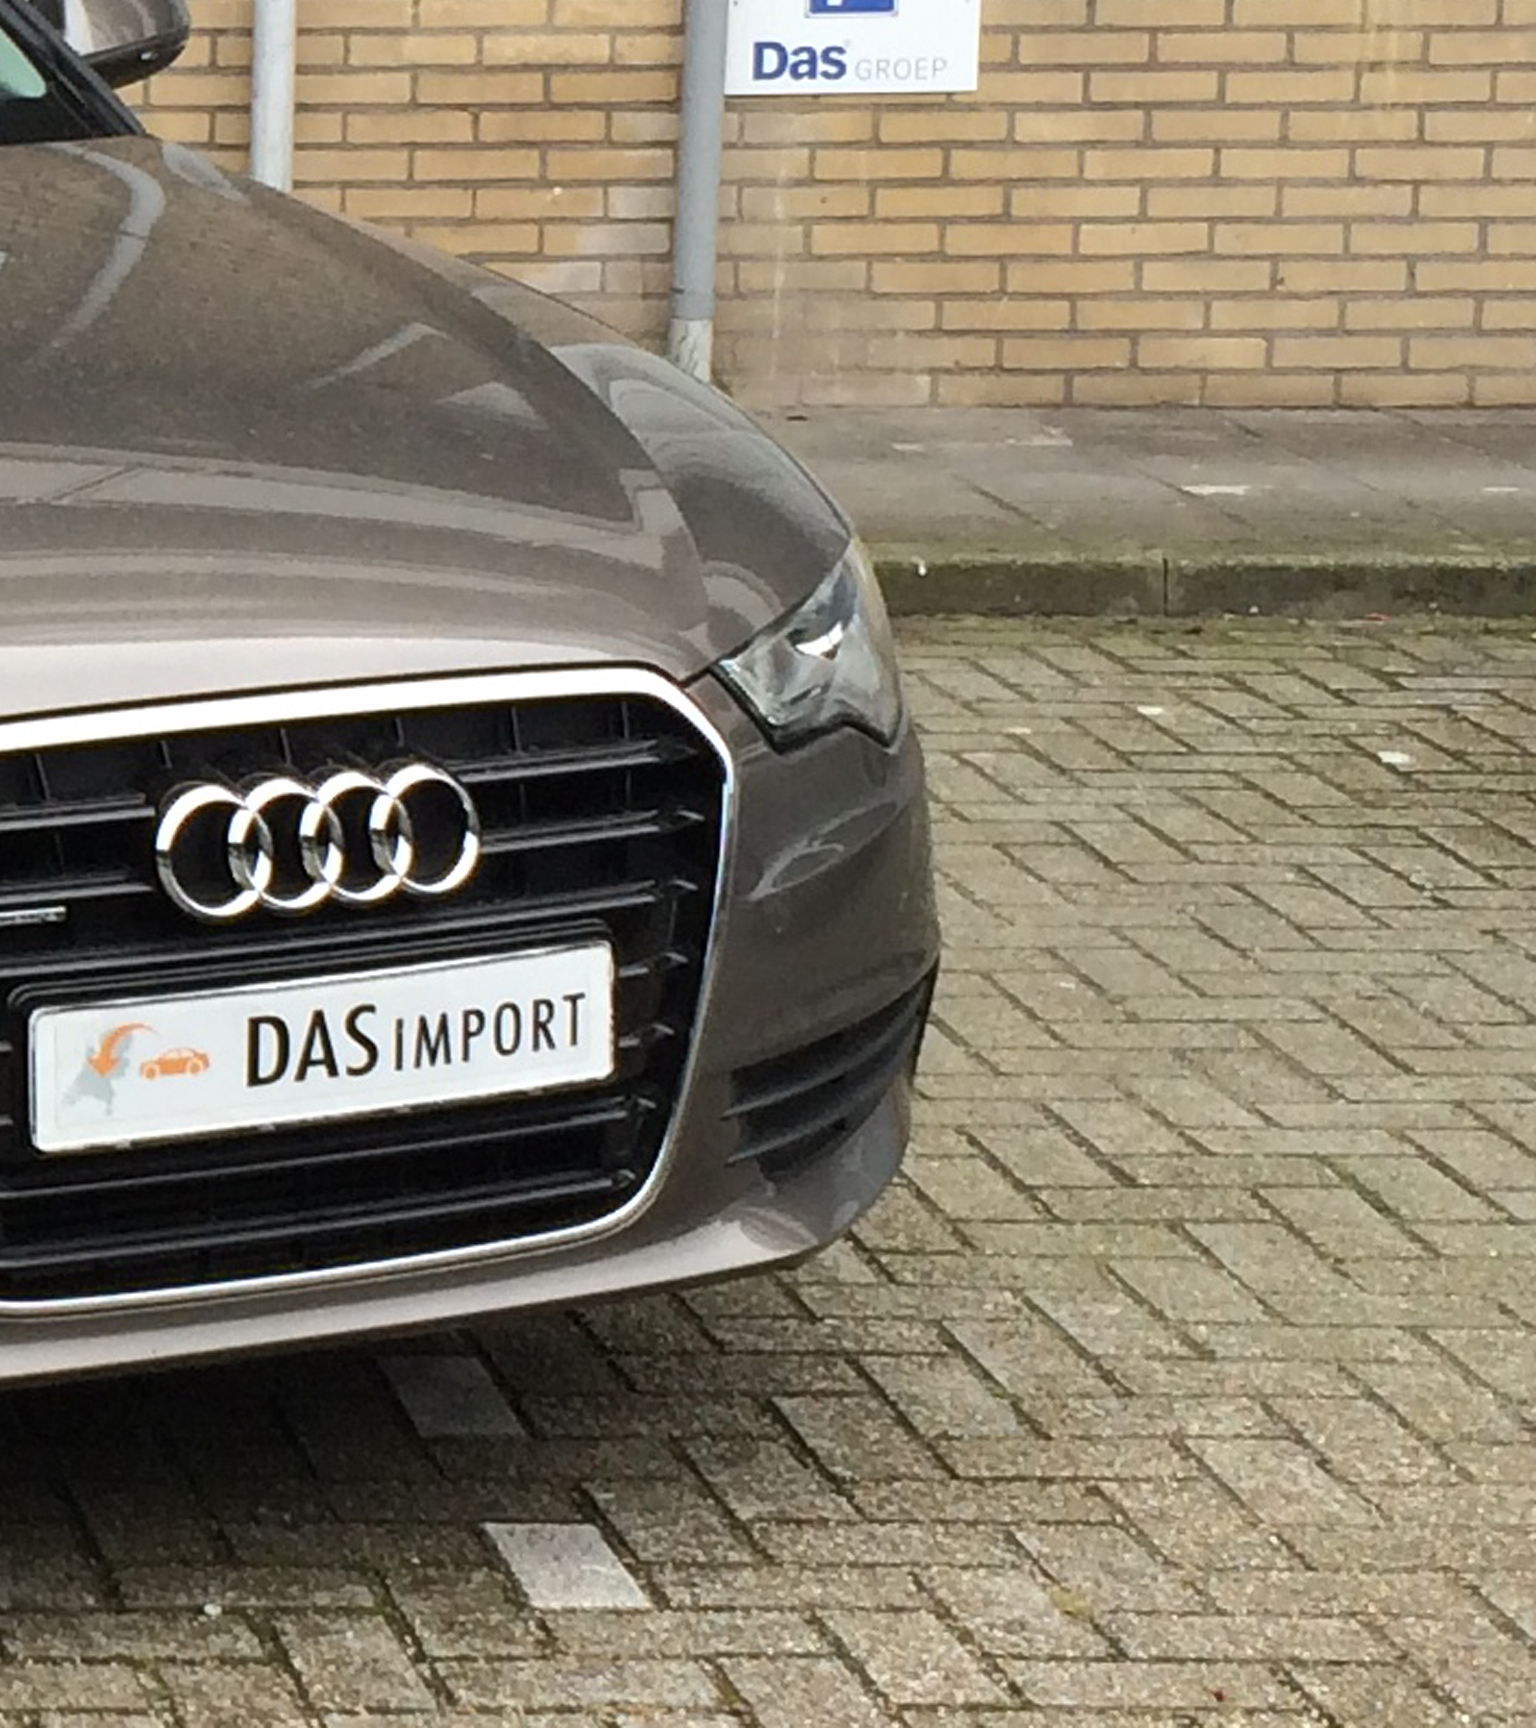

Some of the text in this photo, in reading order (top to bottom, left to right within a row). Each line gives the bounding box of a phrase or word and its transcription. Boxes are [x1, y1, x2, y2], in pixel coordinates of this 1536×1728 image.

[752, 41, 949, 83] Das GROEP
[246, 1003, 380, 1089] DAS
